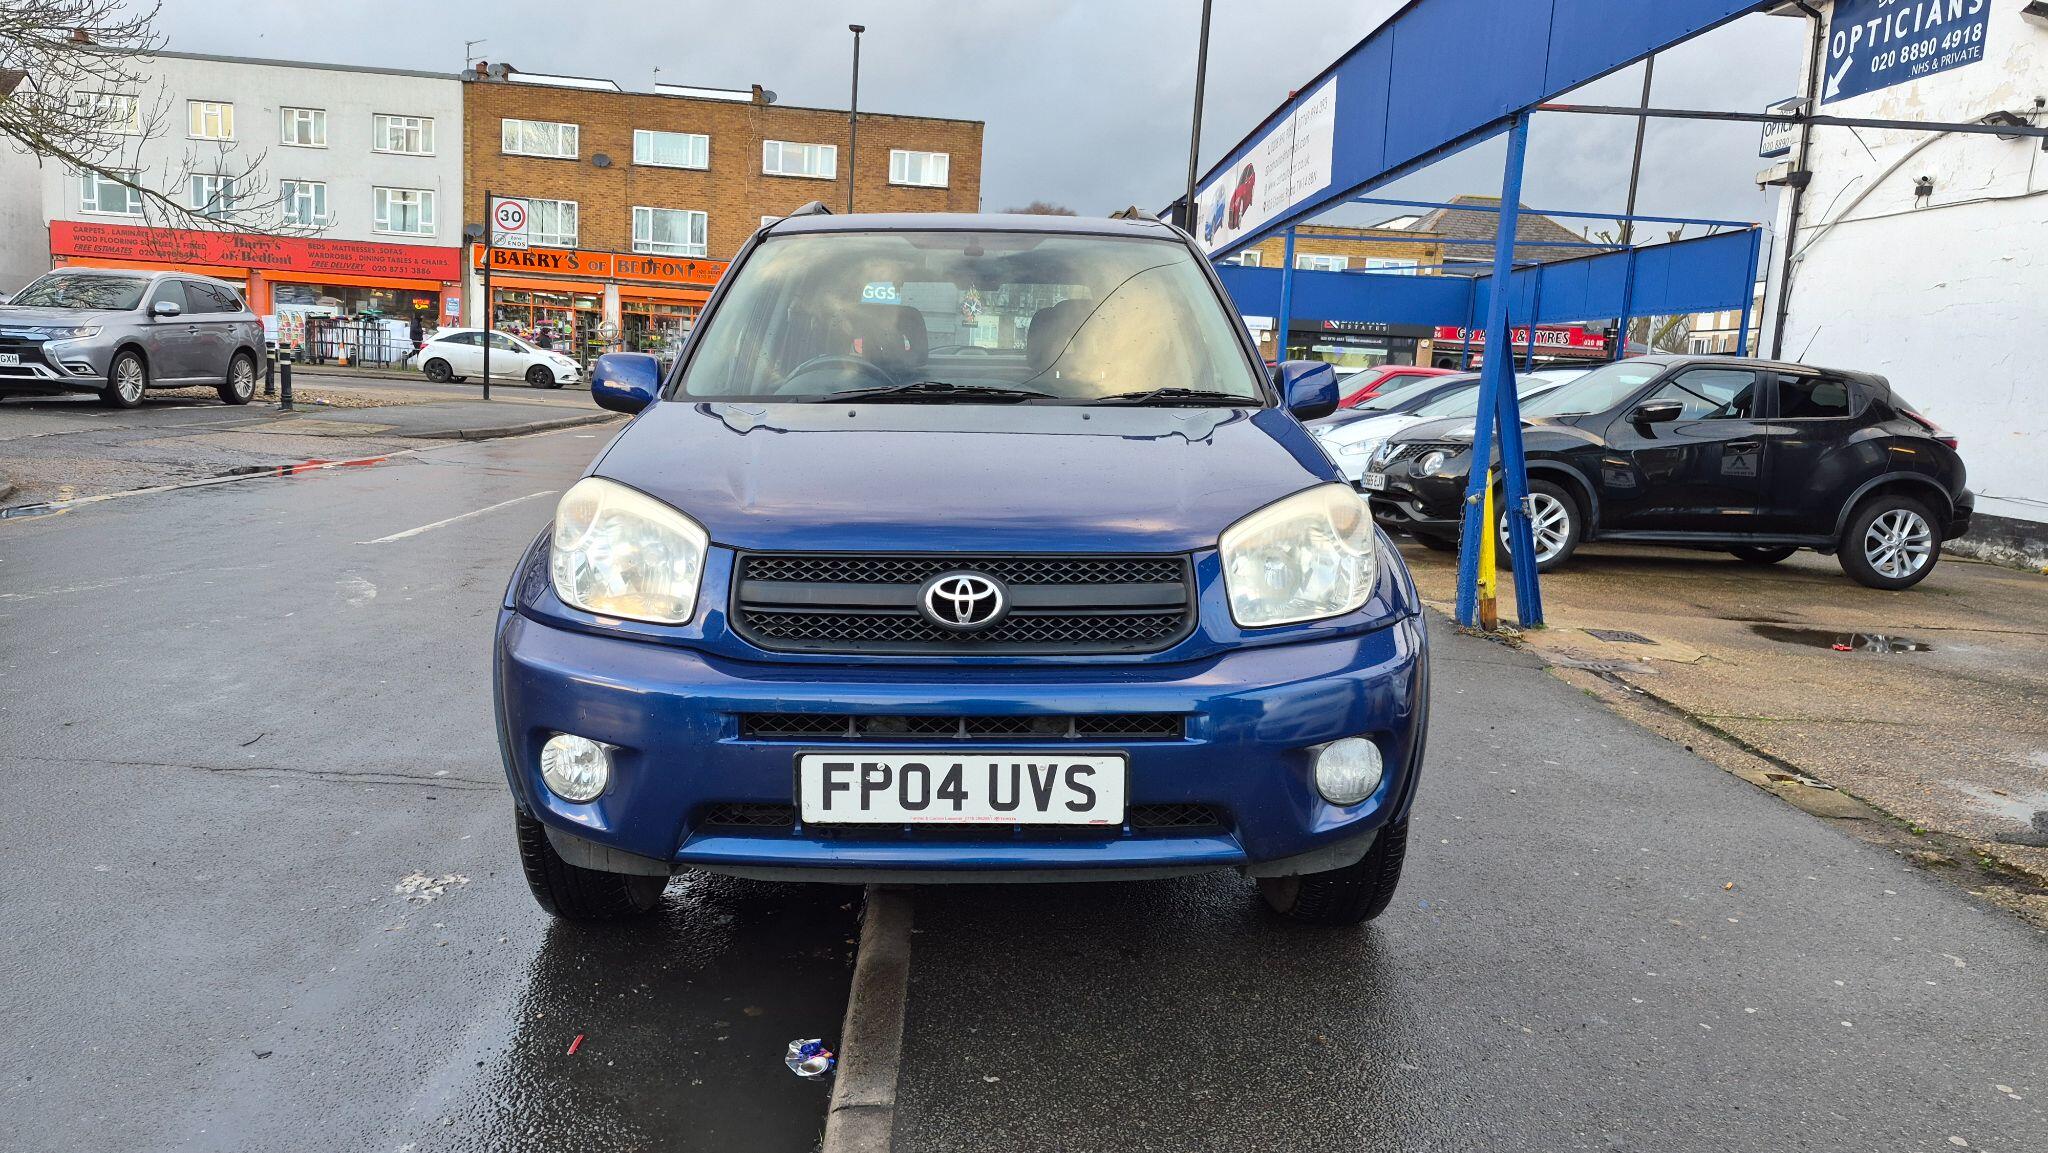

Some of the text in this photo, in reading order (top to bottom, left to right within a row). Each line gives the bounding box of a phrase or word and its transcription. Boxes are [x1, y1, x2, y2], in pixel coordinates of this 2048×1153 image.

[1832, 0, 1983, 59] OPTICIANS
[1871, 22, 1983, 73] 020 8890 4918
[1911, 45, 1981, 76] NHS & PRIVATE
[500, 209, 522, 223] 30
[72, 226, 106, 234] CARPETS
[72, 234, 98, 242] WOOD
[100, 236, 138, 246] FLOORING
[234, 236, 281, 250] Barry's
[93, 245, 133, 254] ESTIMATES
[331, 244, 376, 254] MATTRESSES
[241, 251, 292, 265] Bedfont
[307, 251, 353, 260] WARDROBES
[358, 255, 386, 263] DINING
[387, 256, 412, 264] TABLES
[494, 250, 694, 277] BARRY'S OF BEDFONT
[310, 260, 329, 268] FREE
[330, 261, 366, 270] DELIVERY
[1340, 323, 1387, 332] ESTATES
[1516, 331, 1526, 343] &
[1533, 329, 1570, 345] TYRES
[0, 354, 18, 364] GXH
[822, 762, 1097, 812] FP04 UVS
